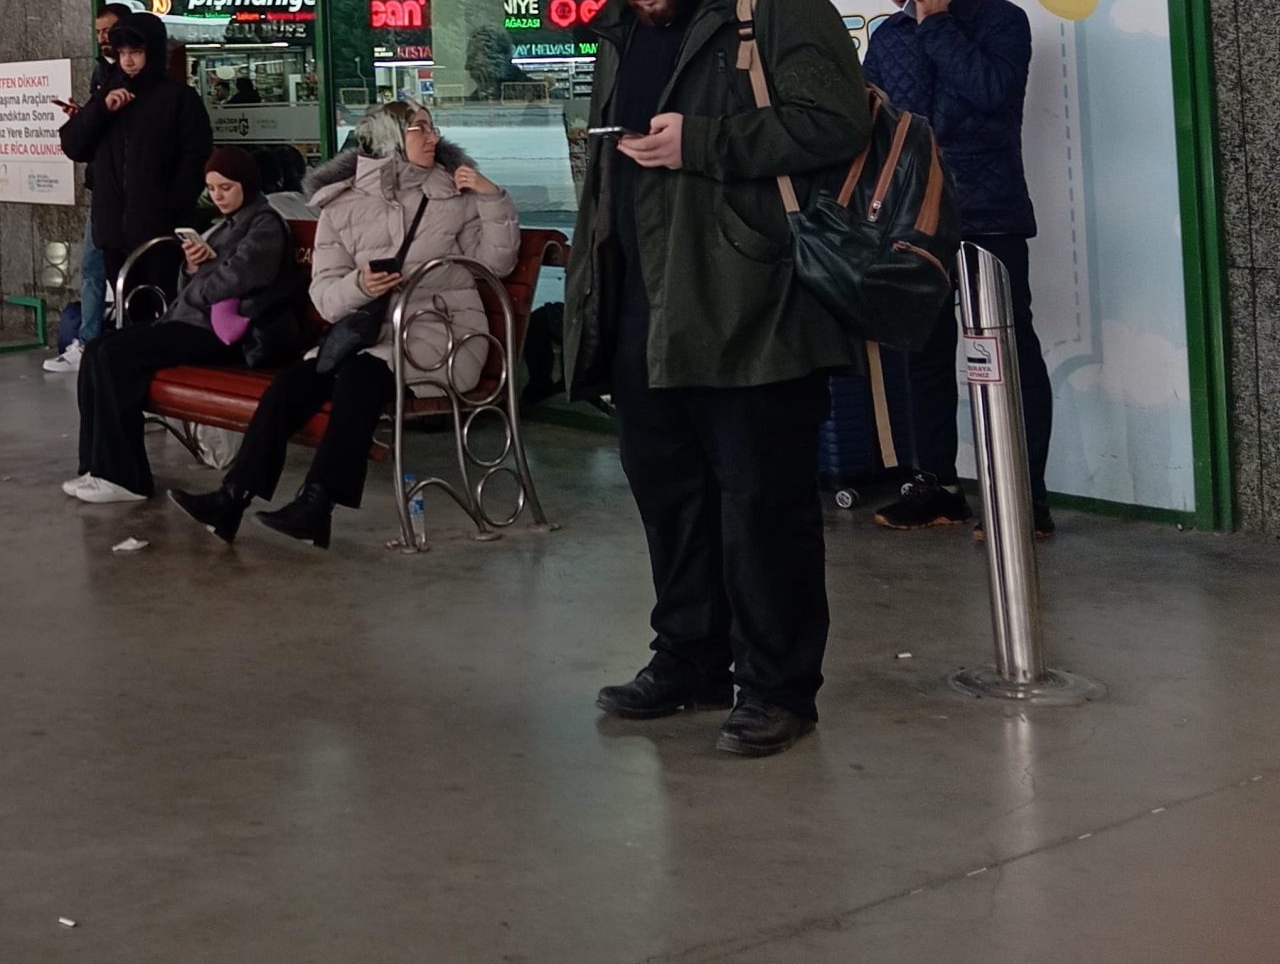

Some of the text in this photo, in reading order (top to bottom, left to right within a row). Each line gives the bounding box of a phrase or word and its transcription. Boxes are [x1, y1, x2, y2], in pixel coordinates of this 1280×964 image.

[32, 110, 55, 121] Sonra
[7, 128, 23, 138] Yere
[11, 141, 28, 155] RİCA
